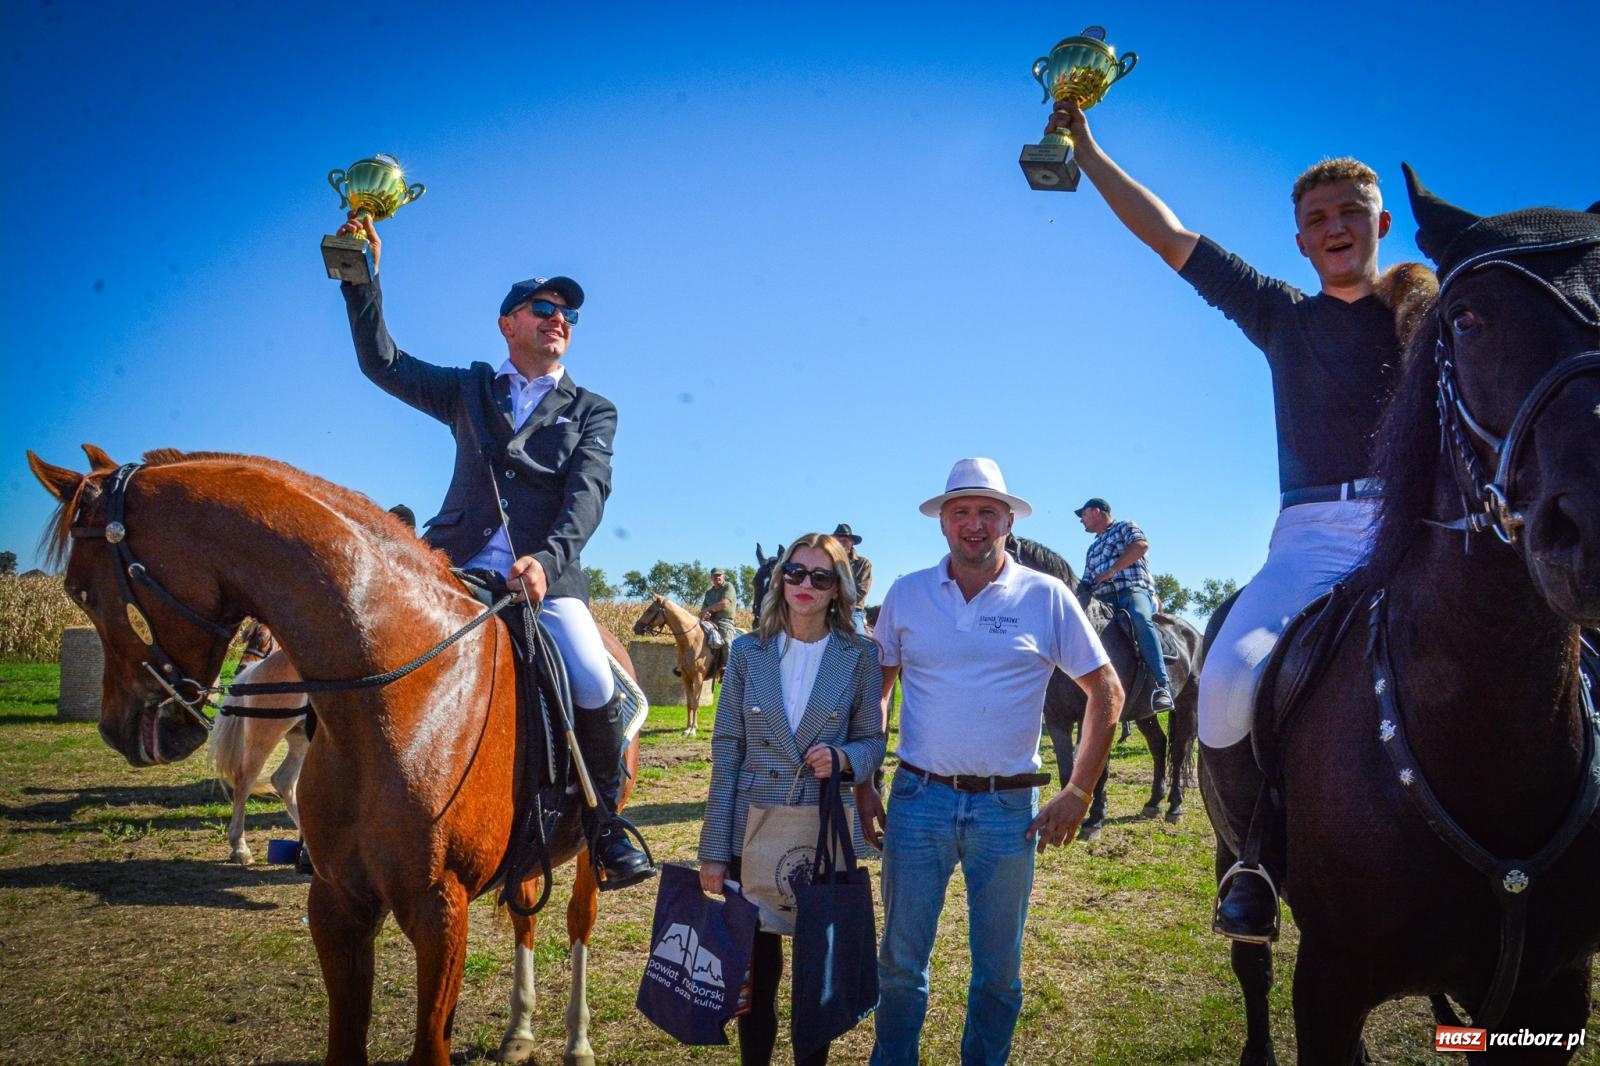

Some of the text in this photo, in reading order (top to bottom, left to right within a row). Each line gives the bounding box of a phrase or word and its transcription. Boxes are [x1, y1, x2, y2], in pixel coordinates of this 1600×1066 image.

[648, 959, 679, 980] powiat
[646, 970, 722, 1011] zielona oaza kultur
